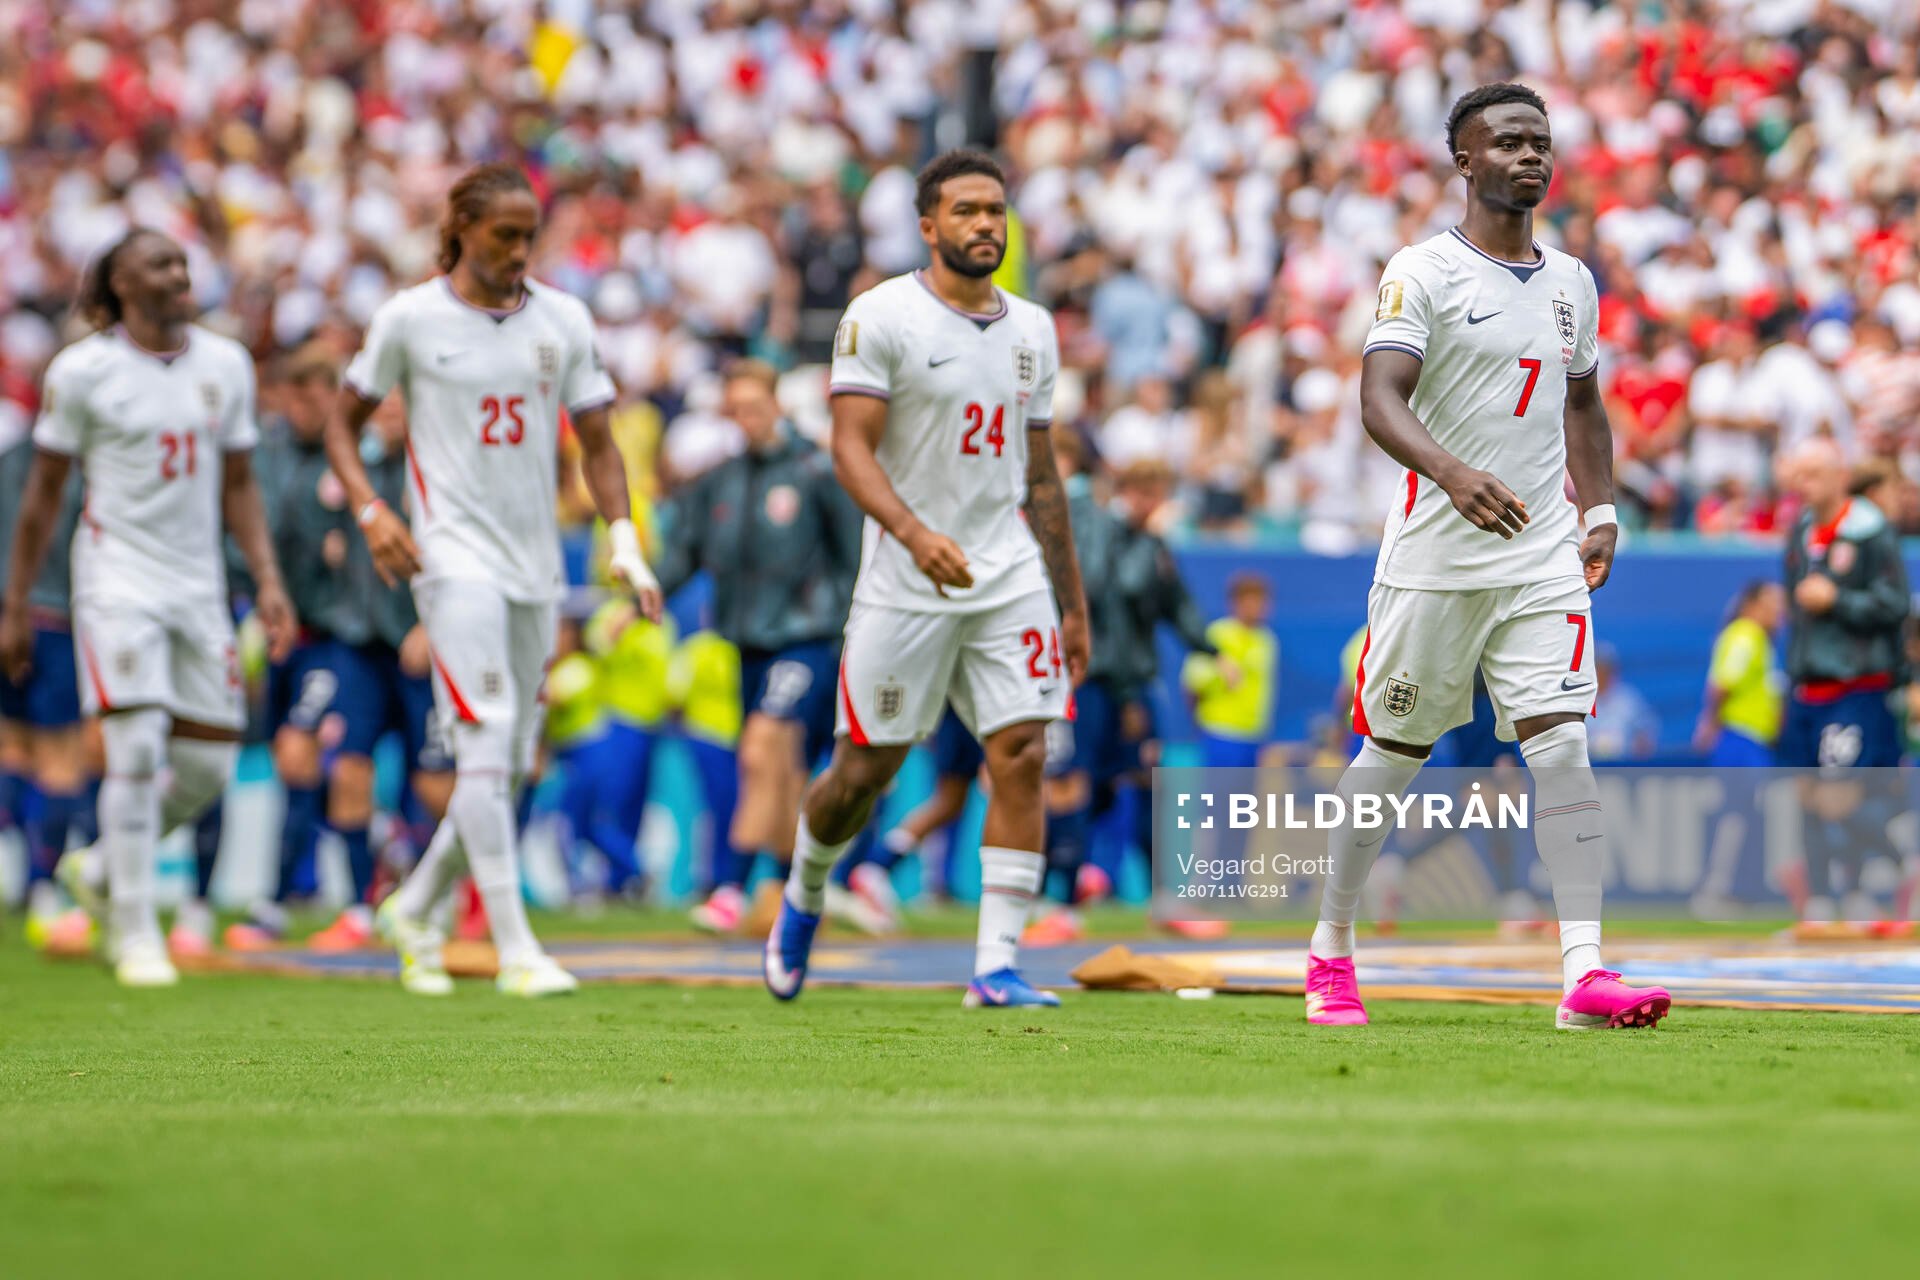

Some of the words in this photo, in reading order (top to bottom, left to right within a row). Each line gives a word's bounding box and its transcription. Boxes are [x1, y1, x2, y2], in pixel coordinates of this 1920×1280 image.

[1513, 357, 1542, 418] 7
[479, 394, 525, 447] 25
[960, 401, 1005, 459] 24
[158, 430, 198, 482] 21
[1021, 627, 1063, 679] 24
[1566, 613, 1587, 672] 7
